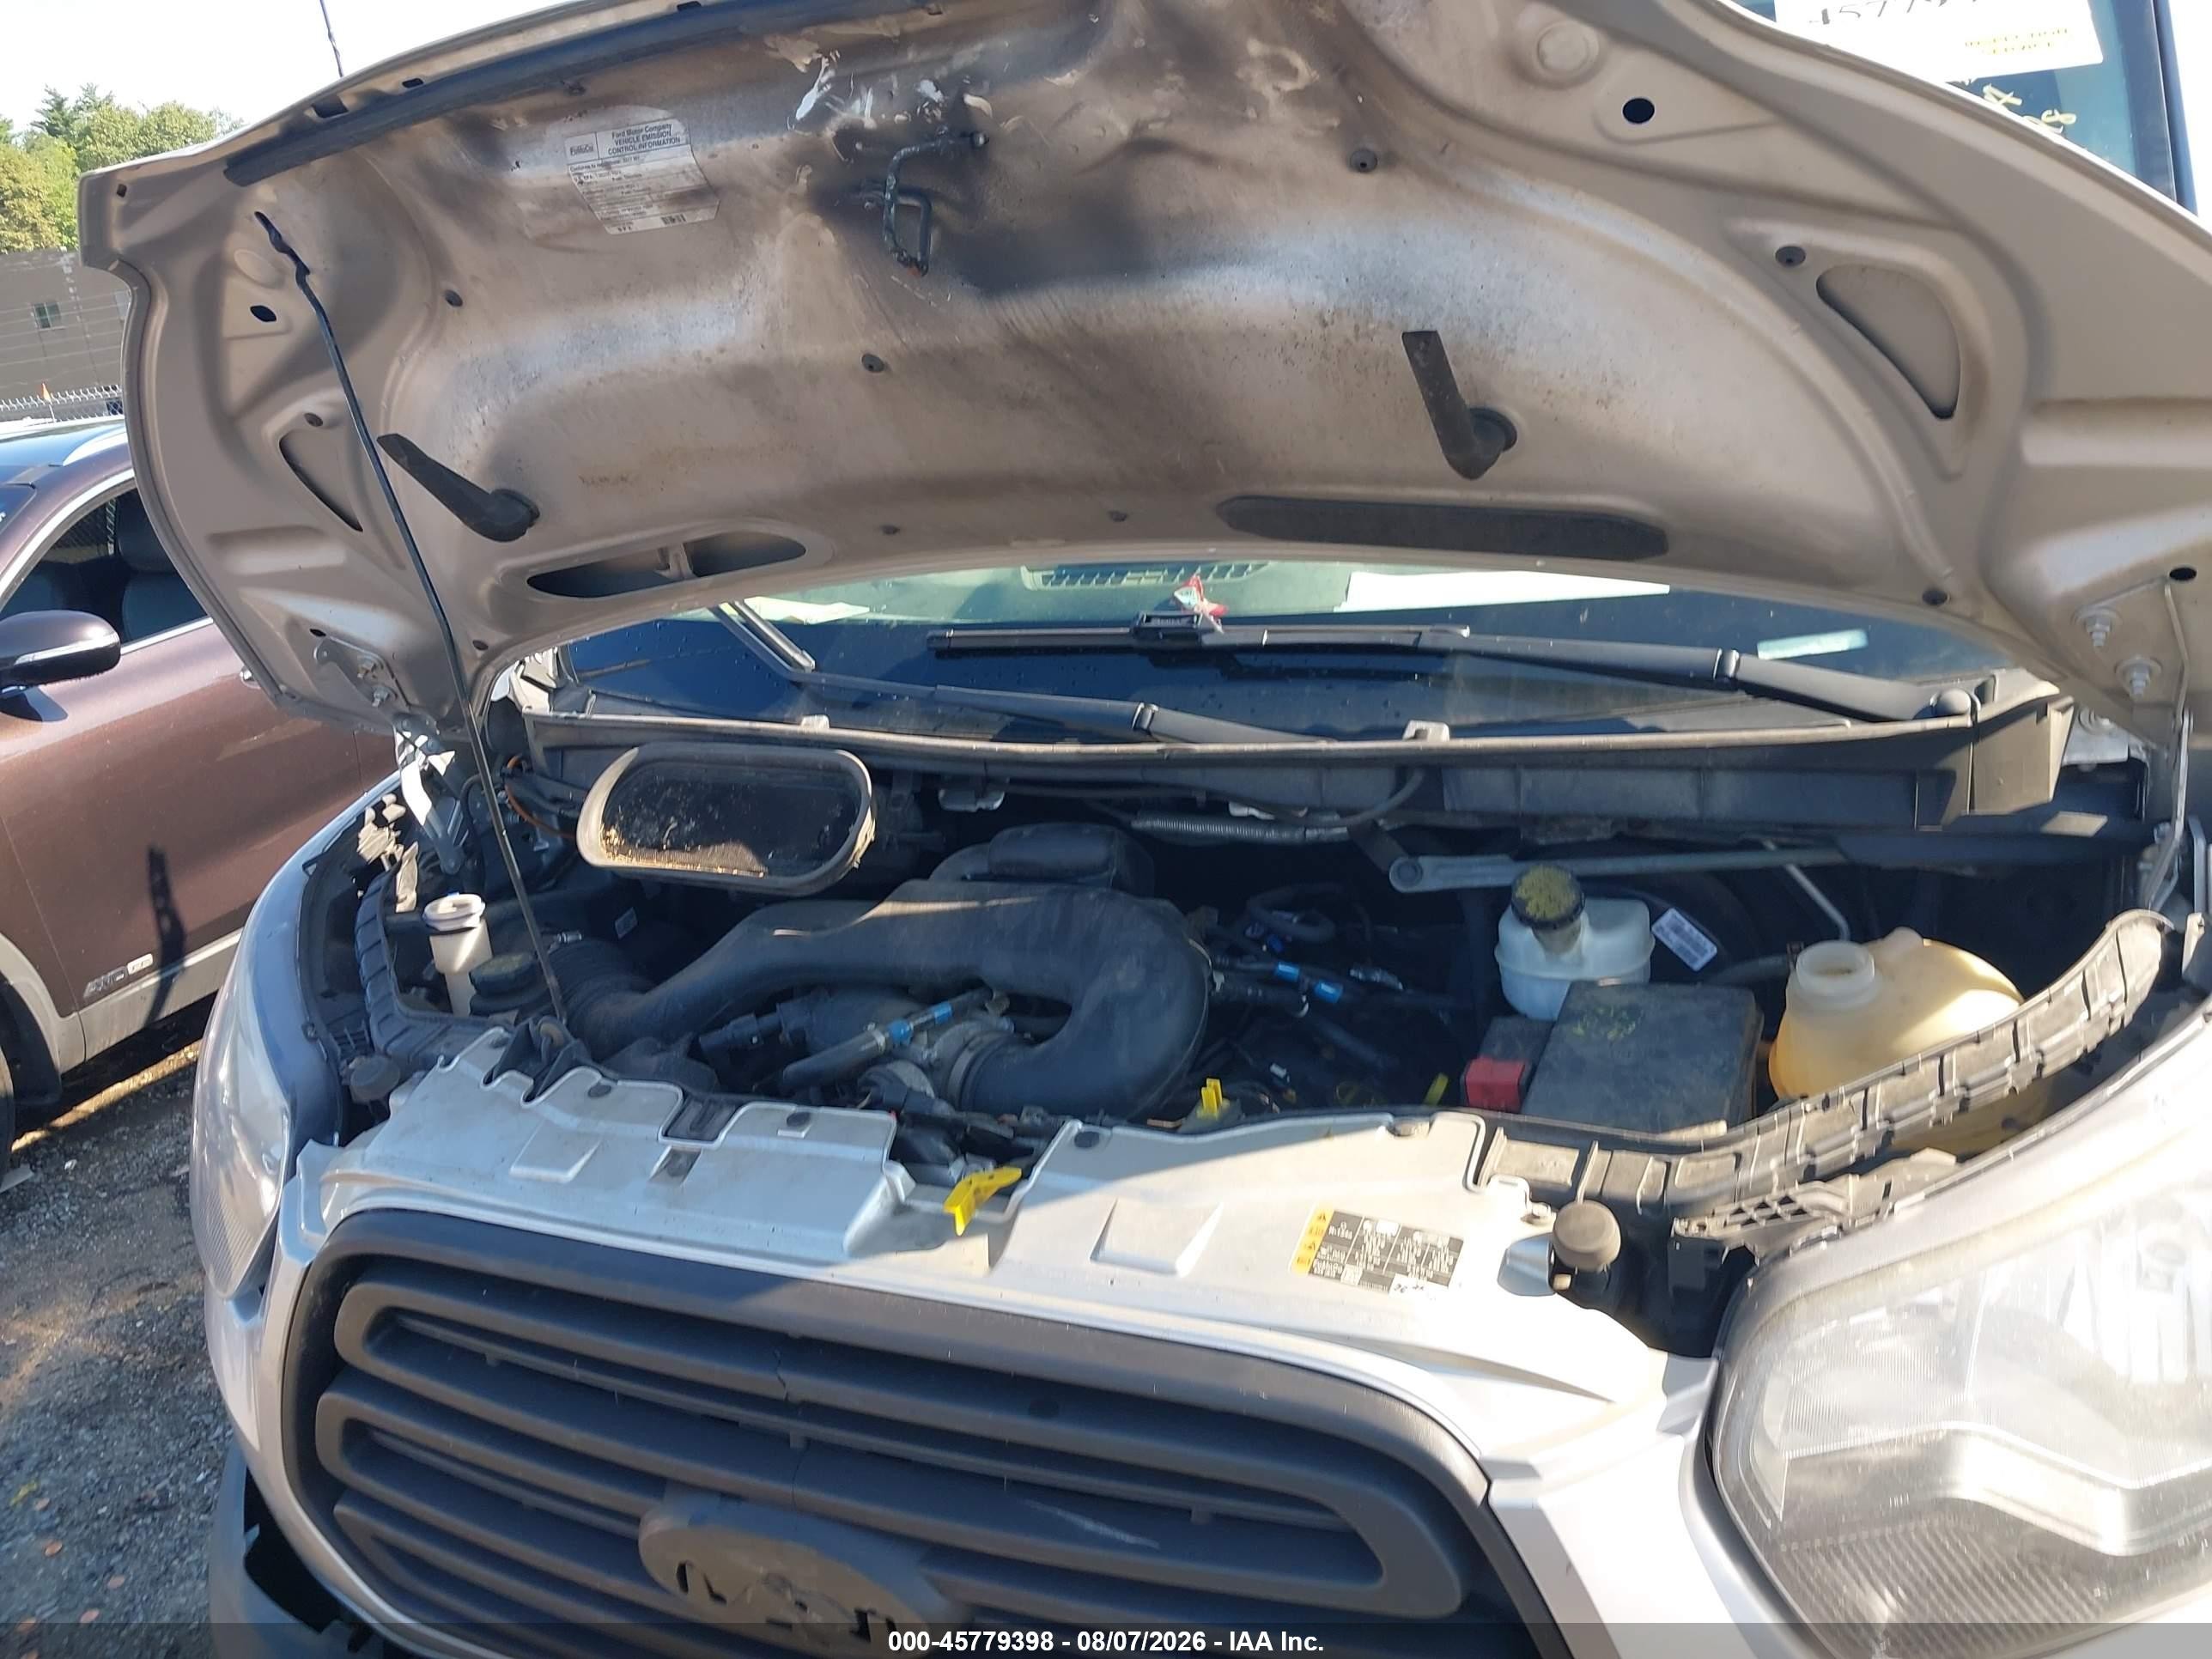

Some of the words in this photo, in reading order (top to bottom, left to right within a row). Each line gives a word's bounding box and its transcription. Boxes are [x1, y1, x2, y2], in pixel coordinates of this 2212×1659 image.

[608, 144, 636, 155] CONTROL
[638, 137, 680, 149] INFORMATION
[614, 136, 640, 146] VEHICLE
[641, 131, 672, 143] EMISSION
